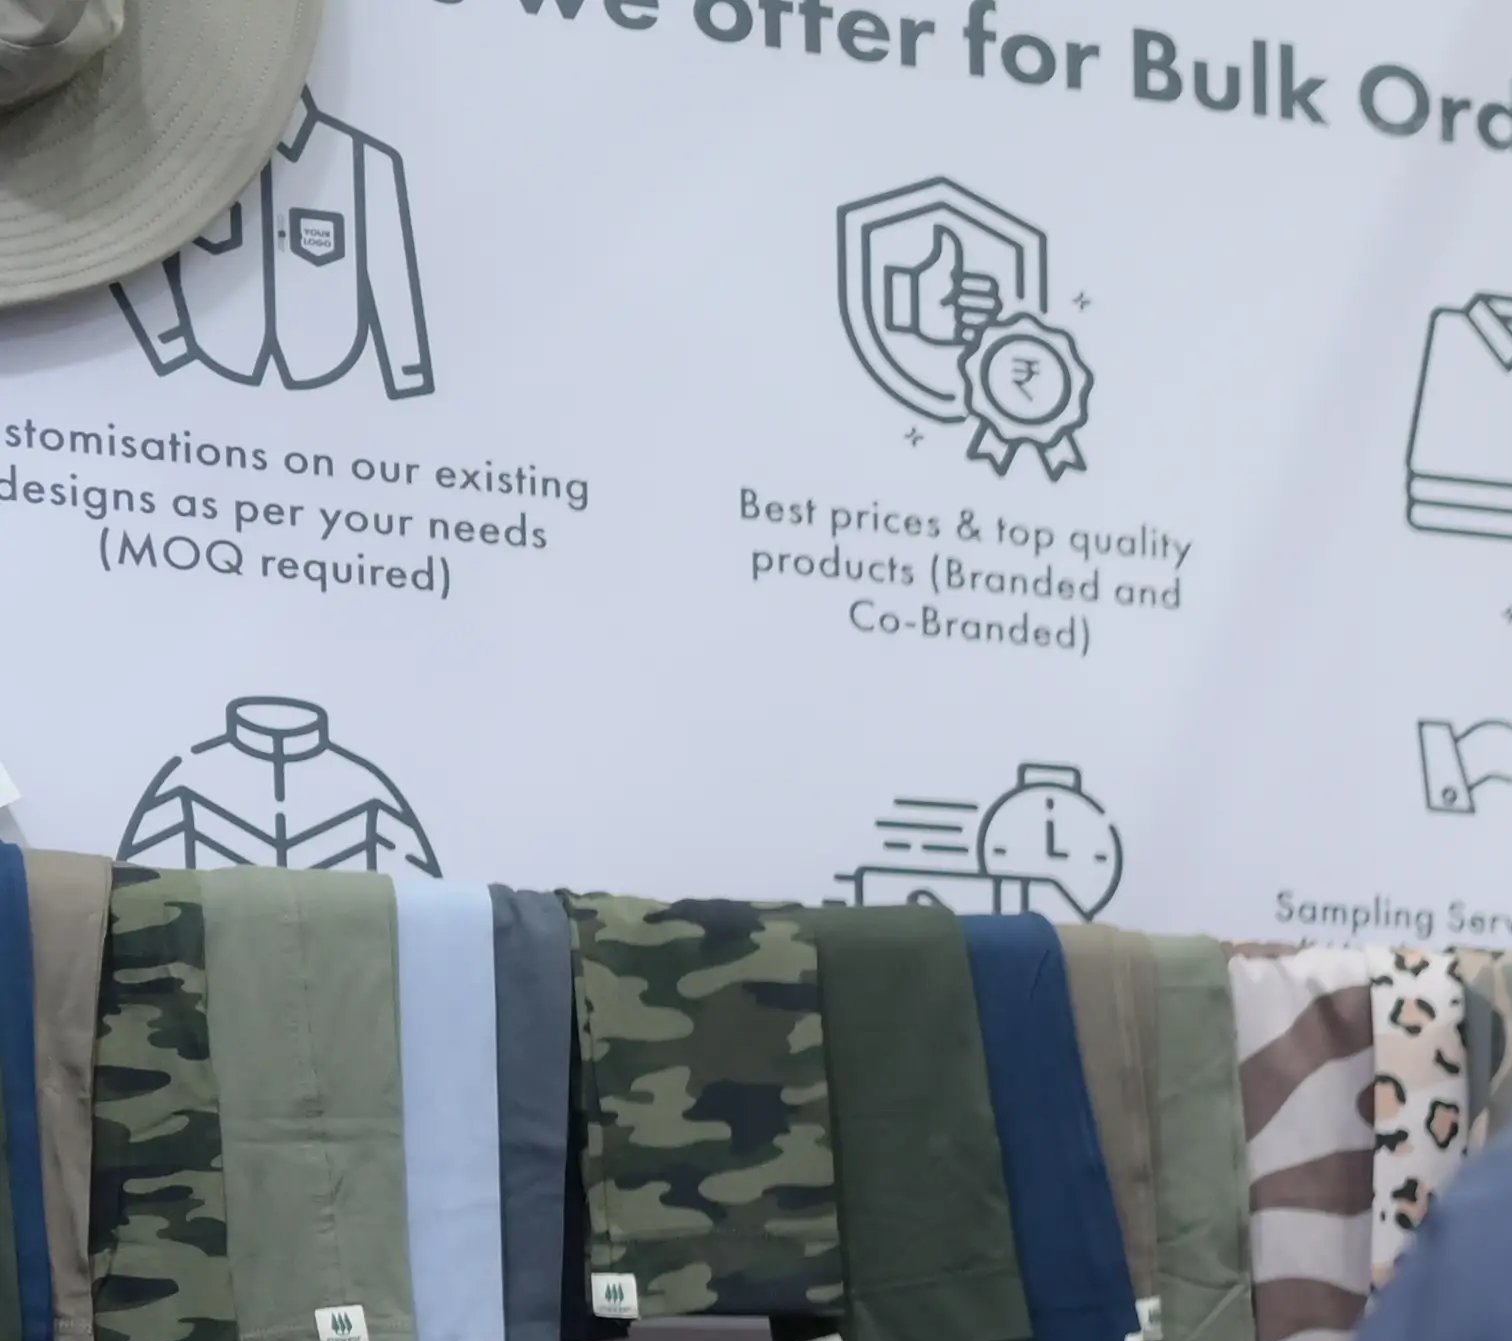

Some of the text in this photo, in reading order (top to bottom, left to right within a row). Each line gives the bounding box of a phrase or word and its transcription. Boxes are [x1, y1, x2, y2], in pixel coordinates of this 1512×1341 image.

[693, 0, 934, 67] offer
[963, 0, 1100, 88] for
[1133, 27, 1328, 125] Bulk
[303, 238, 332, 248] LOGO
[304, 228, 330, 238] YOUR
[5, 419, 589, 510] stomisations on our existing
[172, 492, 218, 519] as
[234, 499, 304, 532] per
[319, 505, 413, 540] your
[429, 512, 547, 549] needs
[739, 488, 1193, 569] Best prices & top quality
[99, 527, 451, 599] (MOQ required)
[752, 545, 1182, 610] products (Branded and
[849, 598, 1090, 657] Co-Branded)
[1275, 891, 1434, 938] Sampling
